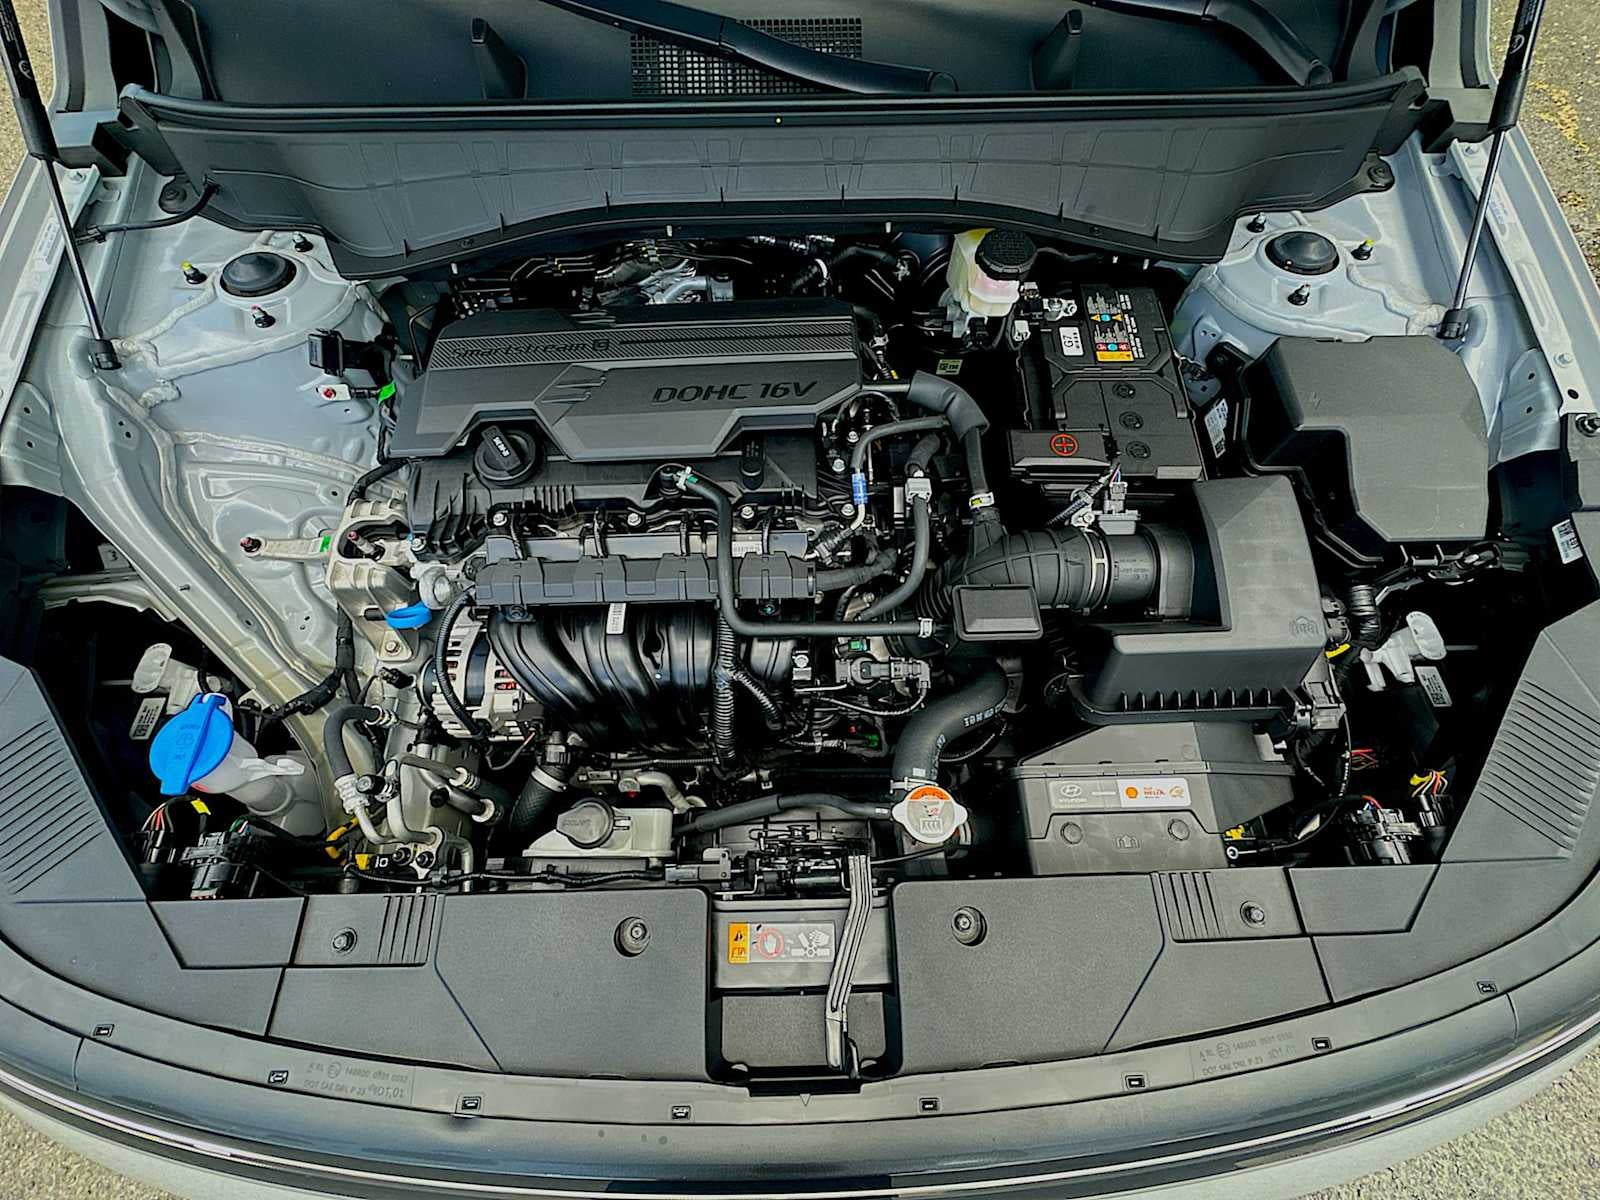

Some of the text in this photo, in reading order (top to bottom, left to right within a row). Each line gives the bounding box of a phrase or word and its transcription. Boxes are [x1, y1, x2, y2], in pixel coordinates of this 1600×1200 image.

[451, 342, 588, 359] Smartstream
[653, 380, 818, 403] DOHC 16V
